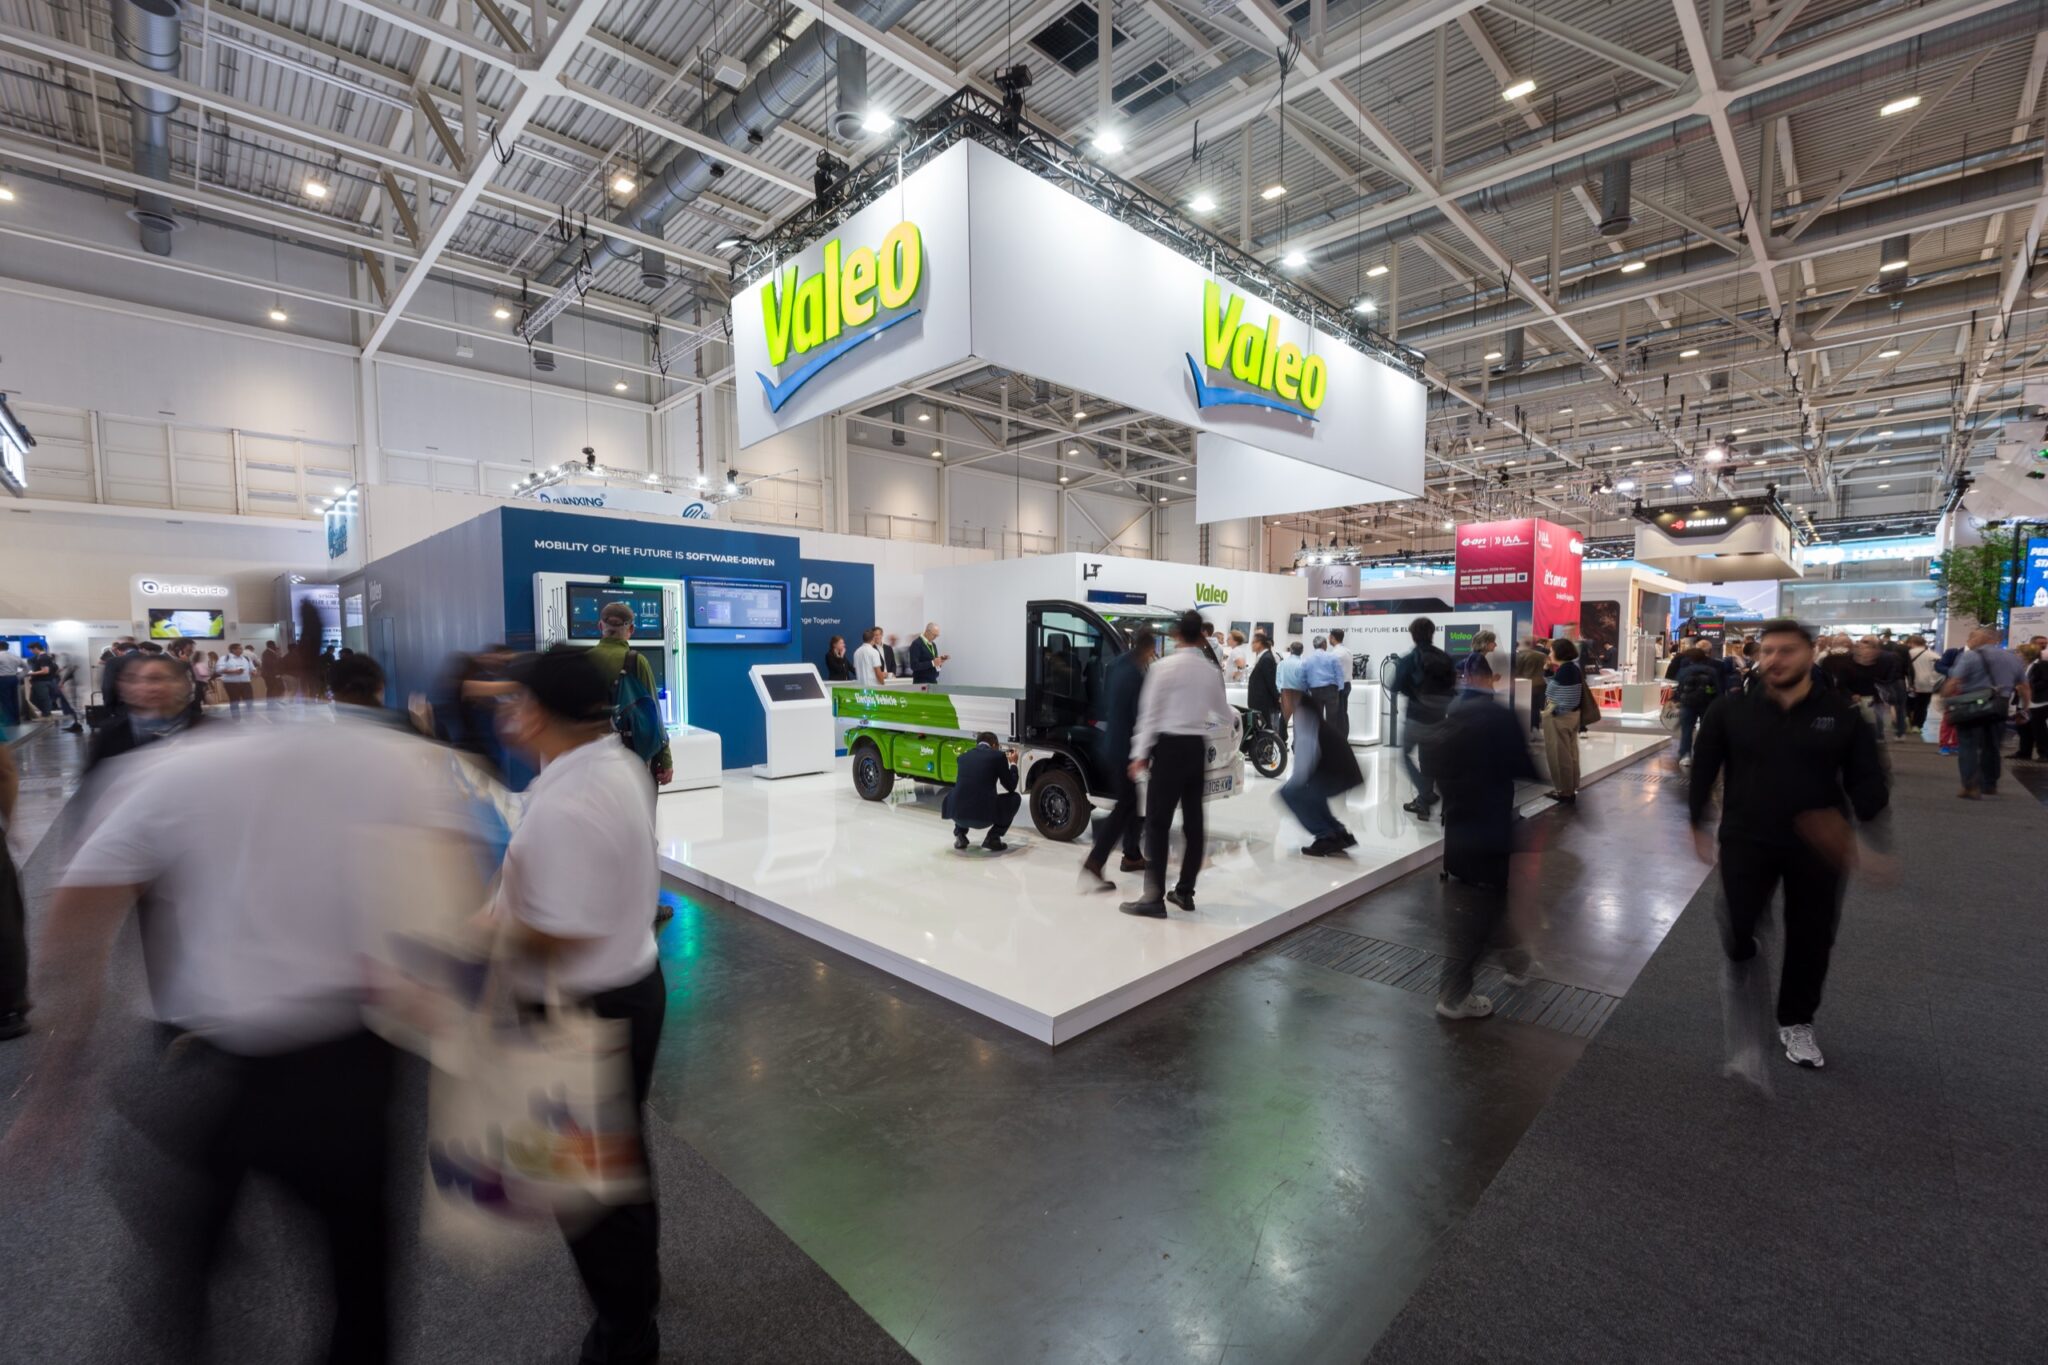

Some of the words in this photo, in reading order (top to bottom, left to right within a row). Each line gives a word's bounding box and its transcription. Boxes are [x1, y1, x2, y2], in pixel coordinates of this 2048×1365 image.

[760, 221, 923, 366] Valeo
[1202, 278, 1328, 410] Valeo
[1685, 517, 1727, 528] PHINIA
[534, 539, 589, 552] MOBILITY
[592, 544, 607, 553] OF
[610, 545, 631, 556] THE
[633, 547, 673, 559] FUTURE
[675, 551, 684, 560] IS
[686, 553, 775, 567] SOFTWARE-DRIVEN
[801, 577, 833, 599] leo
[1195, 583, 1228, 604] Valeo
[813, 617, 841, 625] Together
